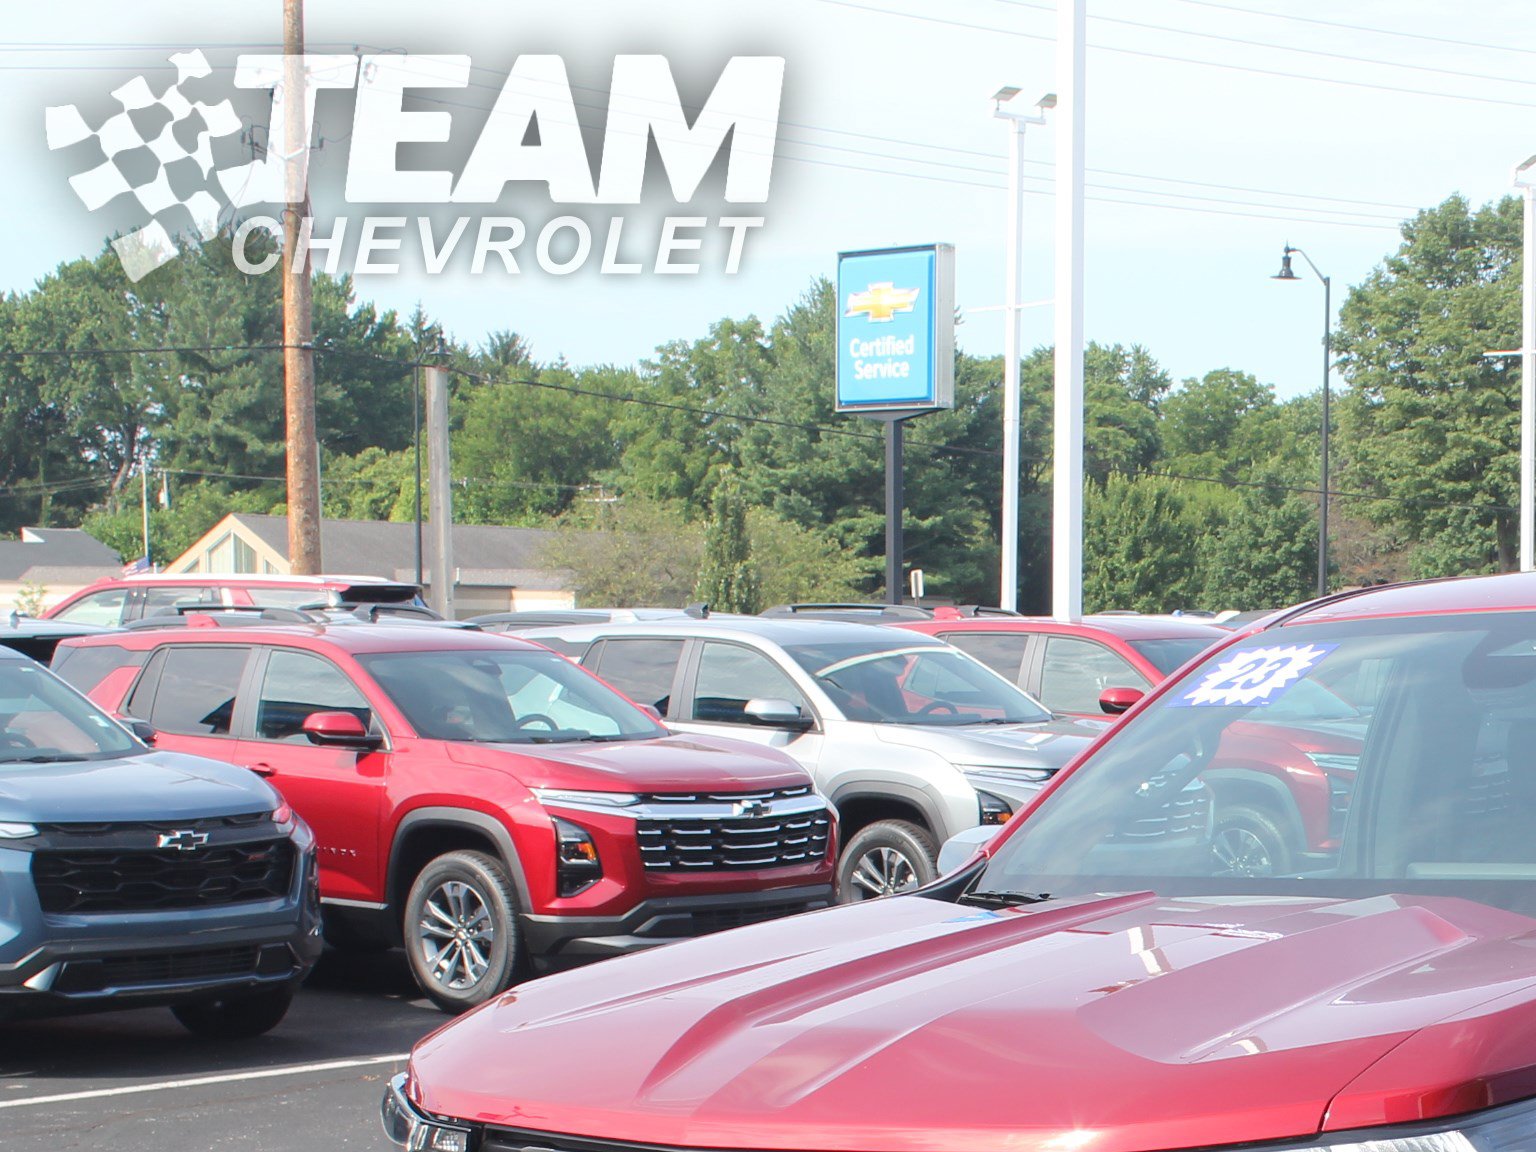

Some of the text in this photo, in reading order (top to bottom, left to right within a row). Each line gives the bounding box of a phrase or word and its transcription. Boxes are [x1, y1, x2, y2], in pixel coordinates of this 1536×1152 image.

[850, 333, 914, 358] Certified
[854, 358, 909, 380] Service
[1210, 657, 1293, 690] 23
